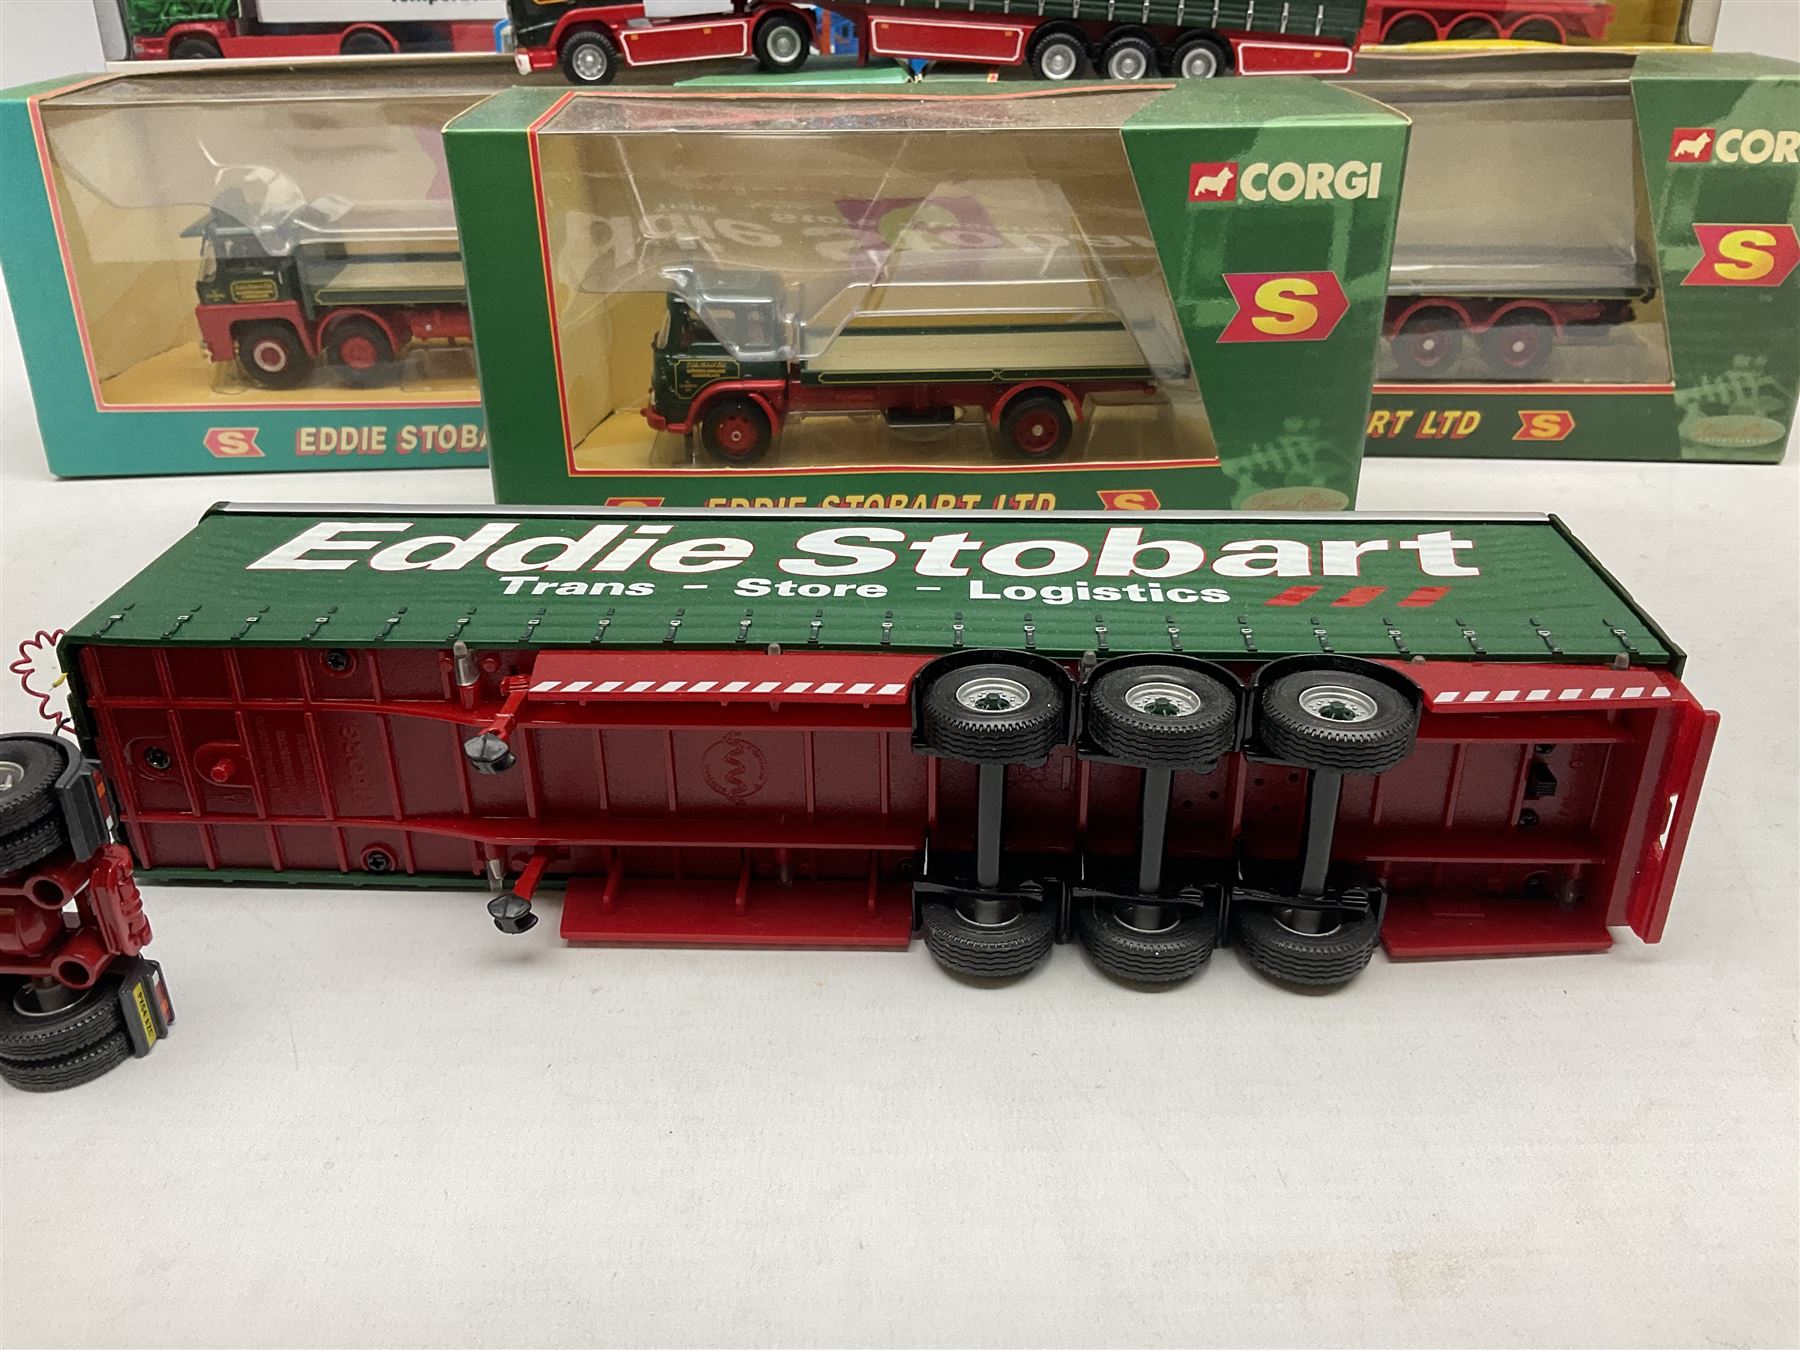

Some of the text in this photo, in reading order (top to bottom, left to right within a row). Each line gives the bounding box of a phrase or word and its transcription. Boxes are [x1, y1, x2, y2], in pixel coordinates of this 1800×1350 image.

[1240, 160, 1382, 202] CORGI
[1714, 229, 1777, 280] S
[1251, 278, 1319, 335] S
[1416, 410, 1482, 439] LTD
[1529, 414, 1561, 438] S
[217, 431, 251, 454] S
[296, 426, 388, 456] EDDIE
[245, 521, 1480, 578] Eddie Stobart
[500, 576, 656, 596] Trans
[734, 577, 888, 598] Store
[969, 579, 1231, 605] Logistics
